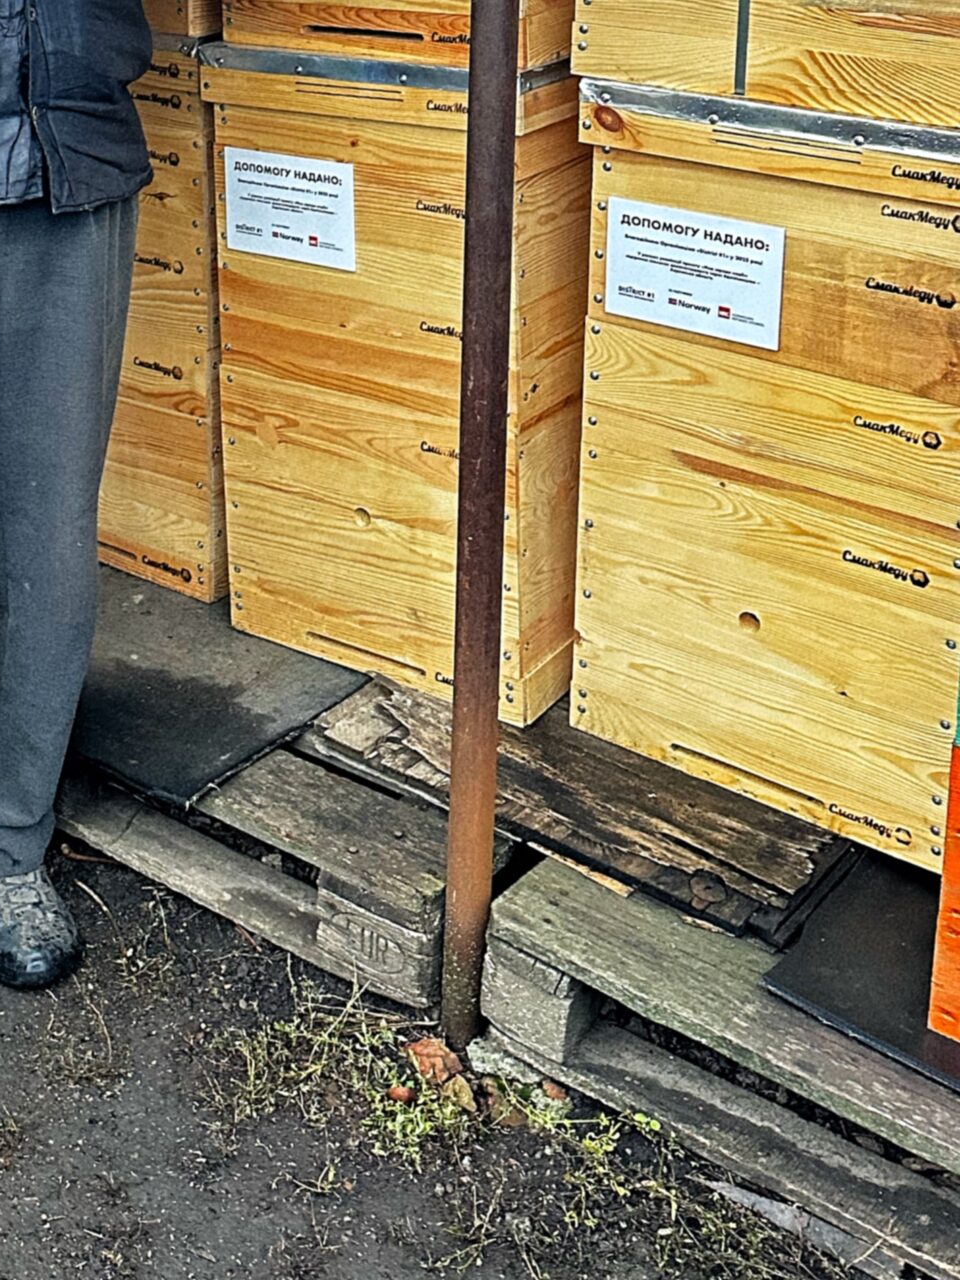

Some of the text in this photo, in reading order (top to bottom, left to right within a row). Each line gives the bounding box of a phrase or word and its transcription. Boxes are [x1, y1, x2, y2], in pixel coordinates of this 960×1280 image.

[431, 31, 471, 45] СмакМе
[426, 99, 470, 114] СмакМе
[234, 161, 342, 186] ДОПОМОГУ НАДАНО:
[881, 204, 951, 230] СмакМеду
[621, 214, 770, 252] ДОПОМОГУ НАДАНО:
[678, 299, 711, 315] Norway
[853, 415, 920, 444] СмакМеду
[842, 549, 909, 582] СмакМеду
